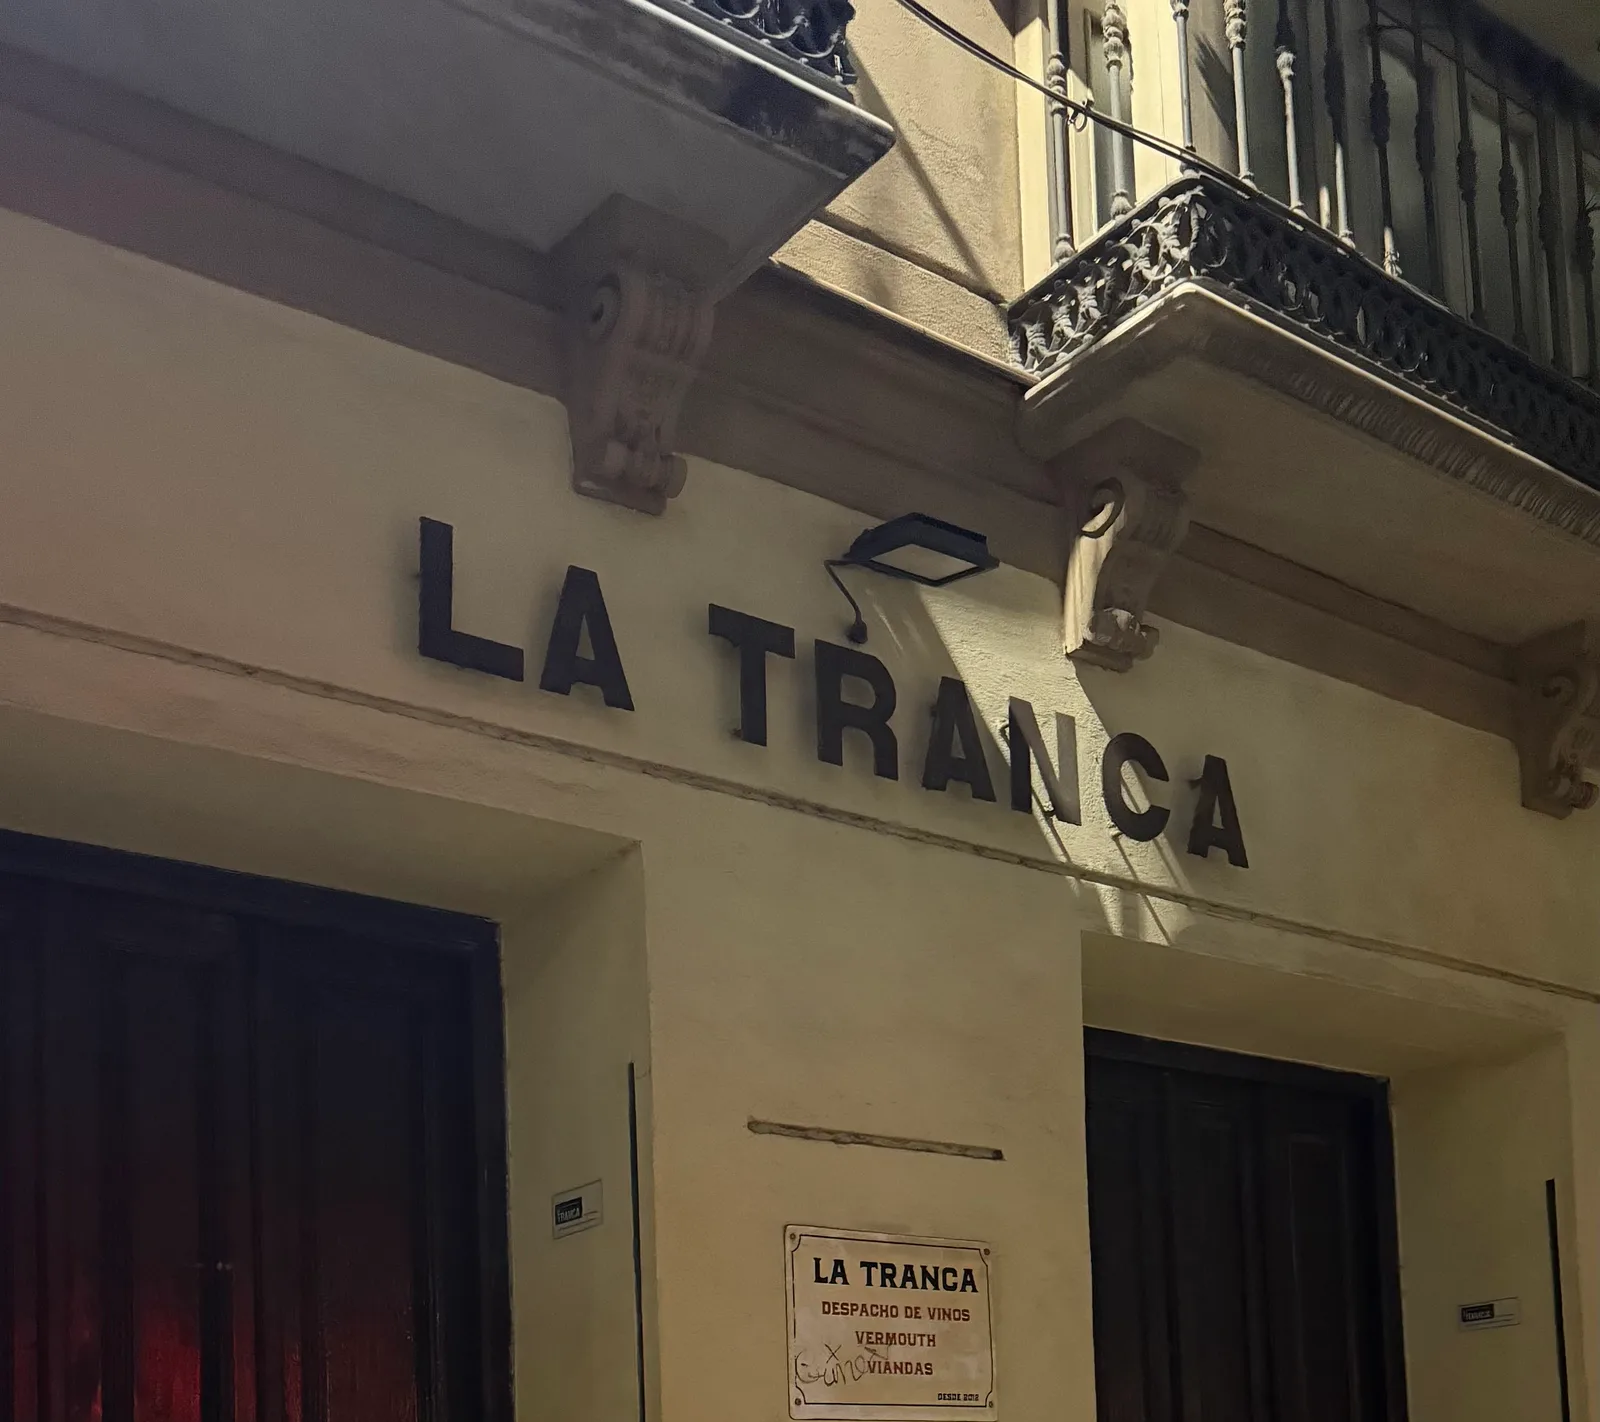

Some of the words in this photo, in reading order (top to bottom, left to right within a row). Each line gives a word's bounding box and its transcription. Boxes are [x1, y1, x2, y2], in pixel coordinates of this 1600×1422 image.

[418, 516, 636, 711] LA
[708, 603, 1249, 869] TRANCA
[813, 1257, 850, 1285] LA
[859, 1260, 979, 1293] TRANCA
[821, 1301, 899, 1319] DESPACHO
[904, 1306, 922, 1319] DE
[928, 1307, 971, 1322] VINOS
[855, 1331, 936, 1347] VERMOUTH
[866, 1360, 934, 1376] VIANDAS
[937, 1393, 961, 1401] DESDE
